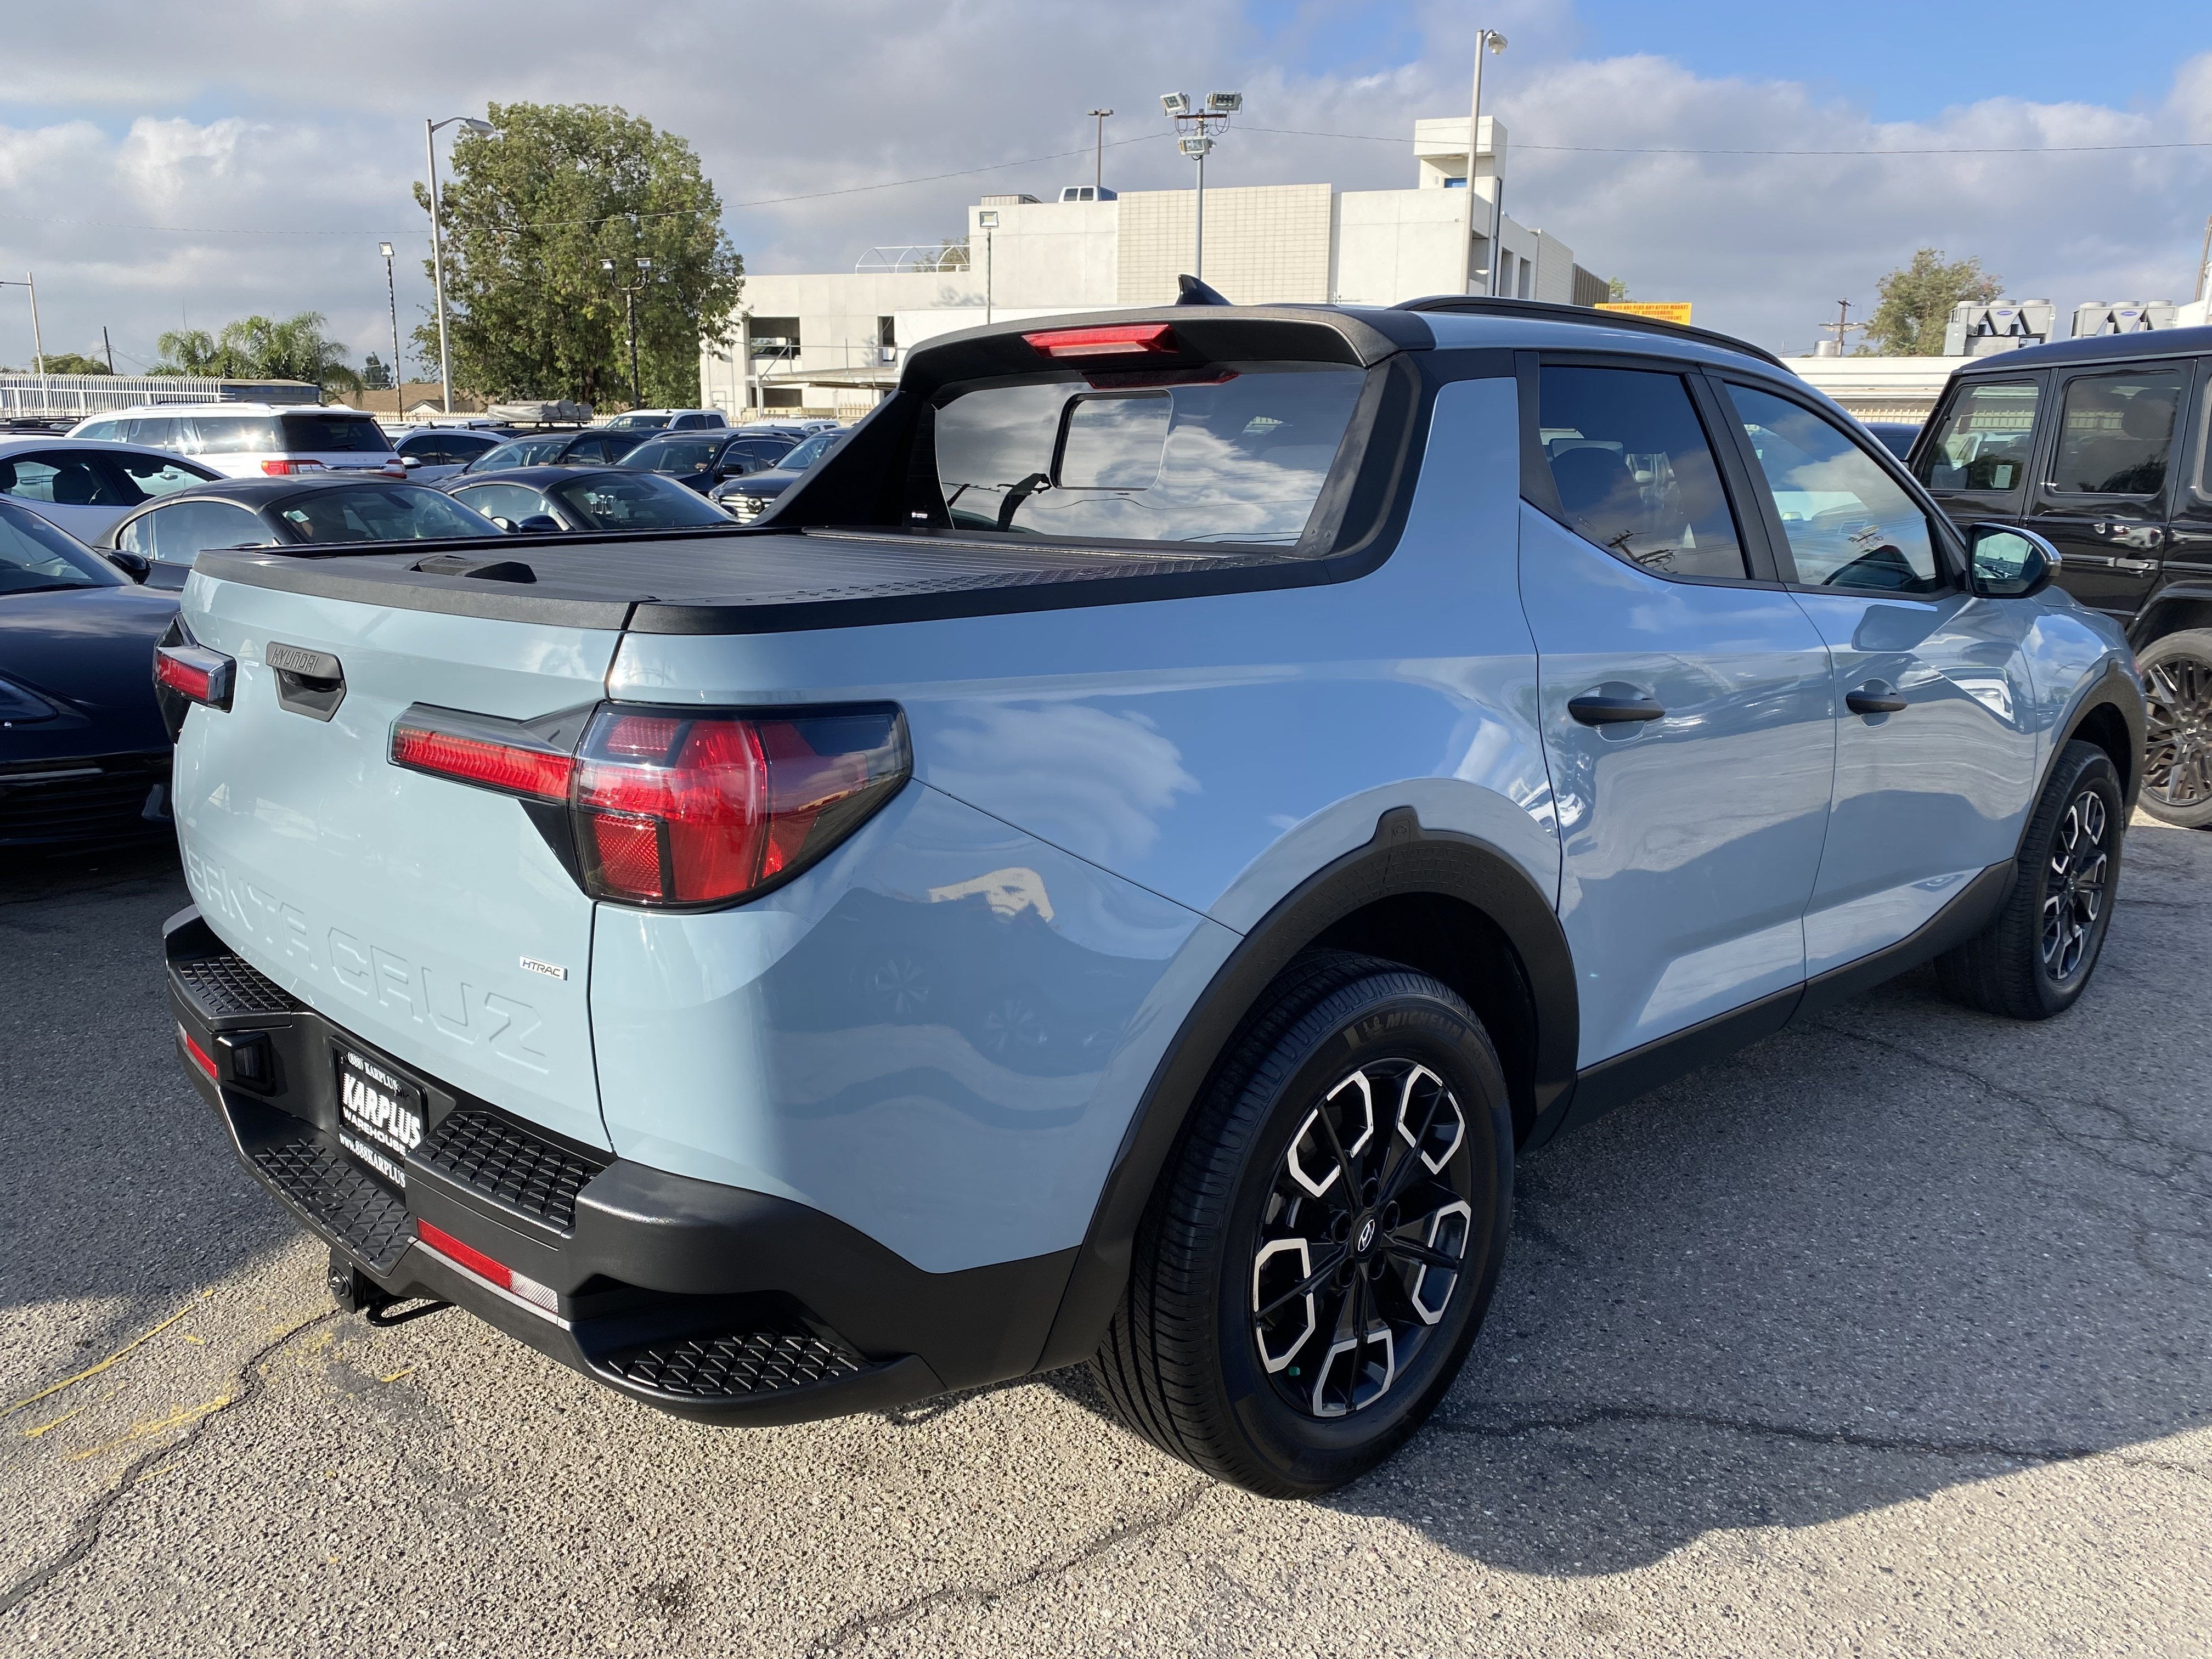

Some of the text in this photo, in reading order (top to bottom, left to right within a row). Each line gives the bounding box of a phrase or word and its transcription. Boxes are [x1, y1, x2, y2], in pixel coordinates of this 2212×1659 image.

[270, 647, 319, 673] HYUNDAI
[522, 959, 560, 977] HTRAC
[328, 927, 550, 1074] CRUZ
[1386, 1011, 1463, 1039] MICHELIN
[347, 1051, 398, 1091] (888) KARPLUS
[342, 1072, 421, 1149] KARPLUS
[342, 1107, 407, 1156] WAREHOUSE
